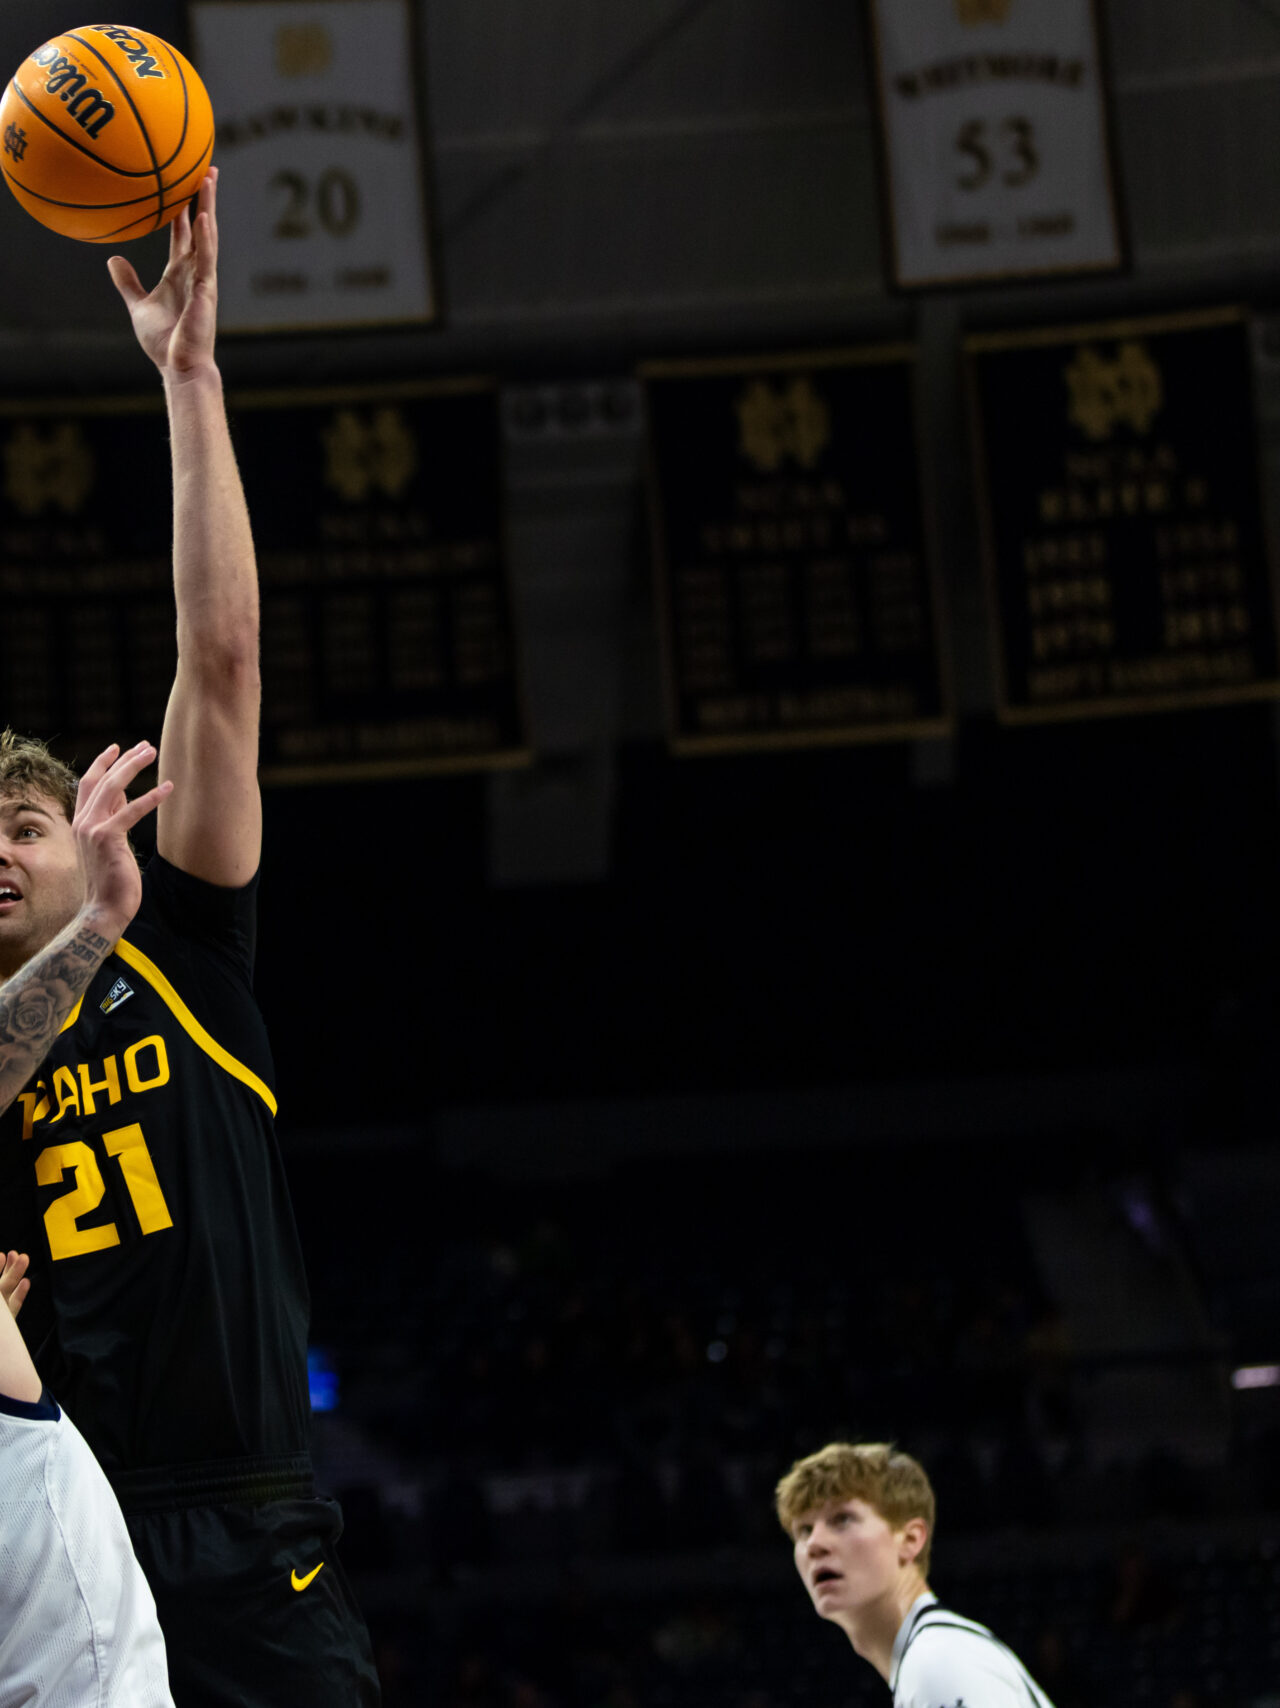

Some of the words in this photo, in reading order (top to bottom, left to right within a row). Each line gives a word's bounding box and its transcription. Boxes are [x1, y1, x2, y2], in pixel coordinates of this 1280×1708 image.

[90, 25, 166, 79] NCAA
[956, 118, 1040, 190] 53
[270, 168, 358, 237] 20
[34, 1122, 174, 1261] 21
